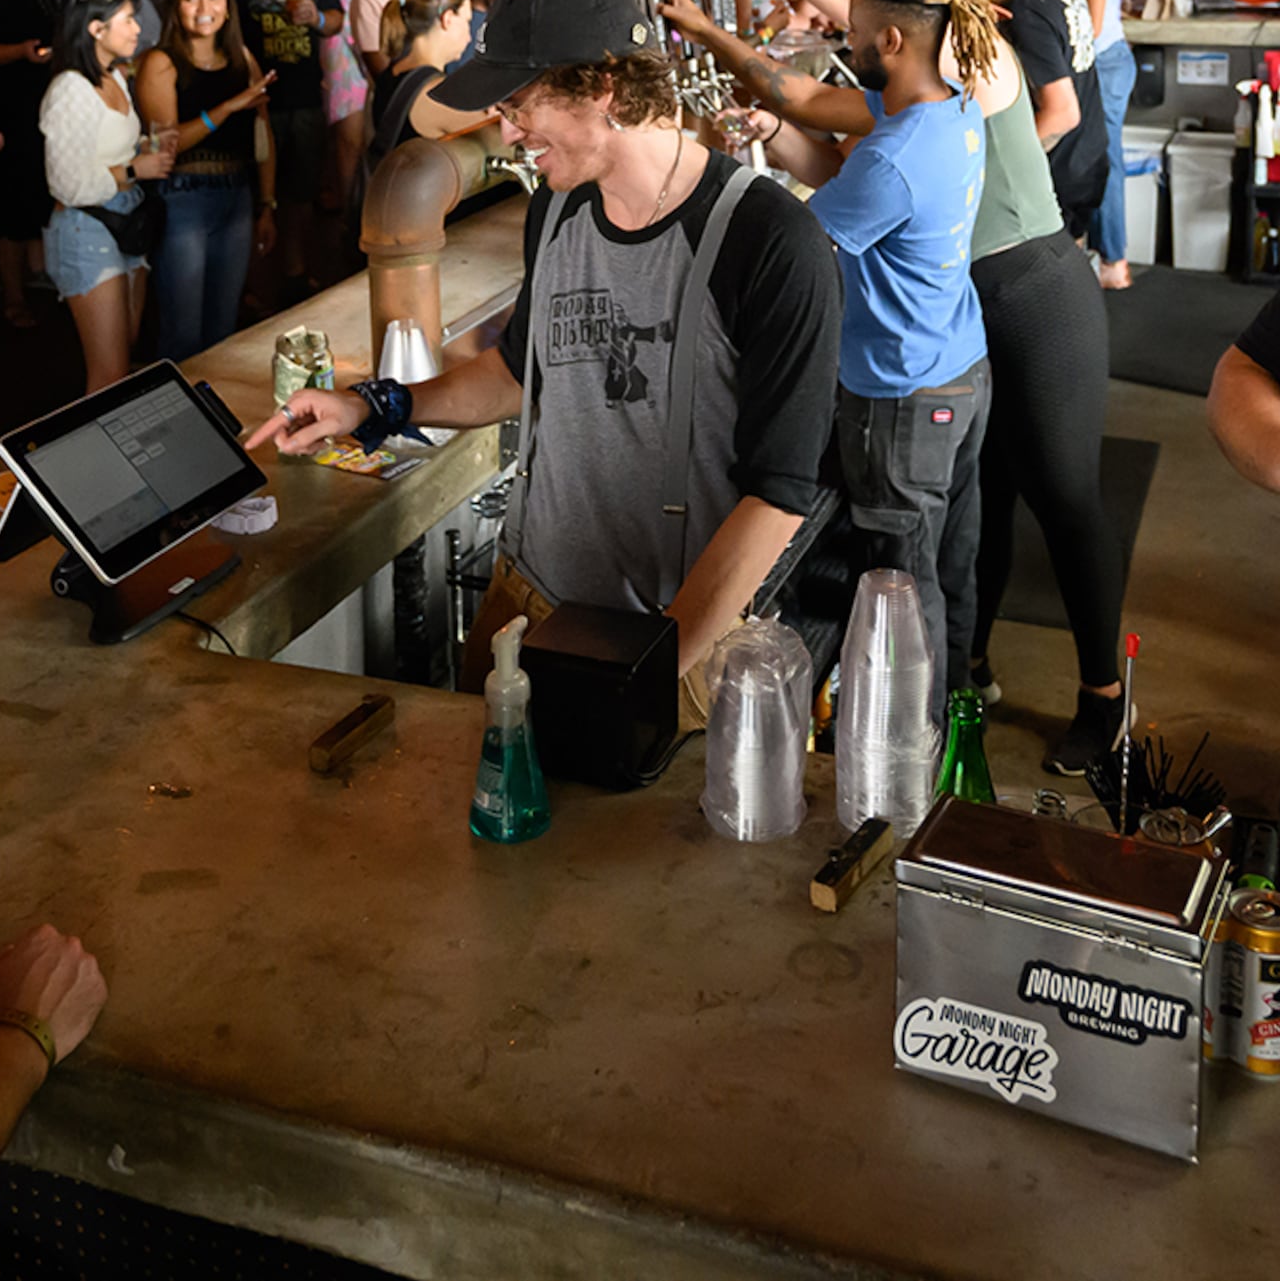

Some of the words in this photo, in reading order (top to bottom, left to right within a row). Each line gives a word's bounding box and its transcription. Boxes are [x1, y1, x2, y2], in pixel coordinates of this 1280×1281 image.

[939, 1004, 997, 1036] MONDAY
[997, 1020, 1038, 1046] NIGHT
[1025, 968, 1118, 1018] MONDAY
[1120, 991, 1186, 1034] NIGHT
[1067, 1011, 1140, 1040] BREWING
[901, 1005, 1051, 1093] Garage
